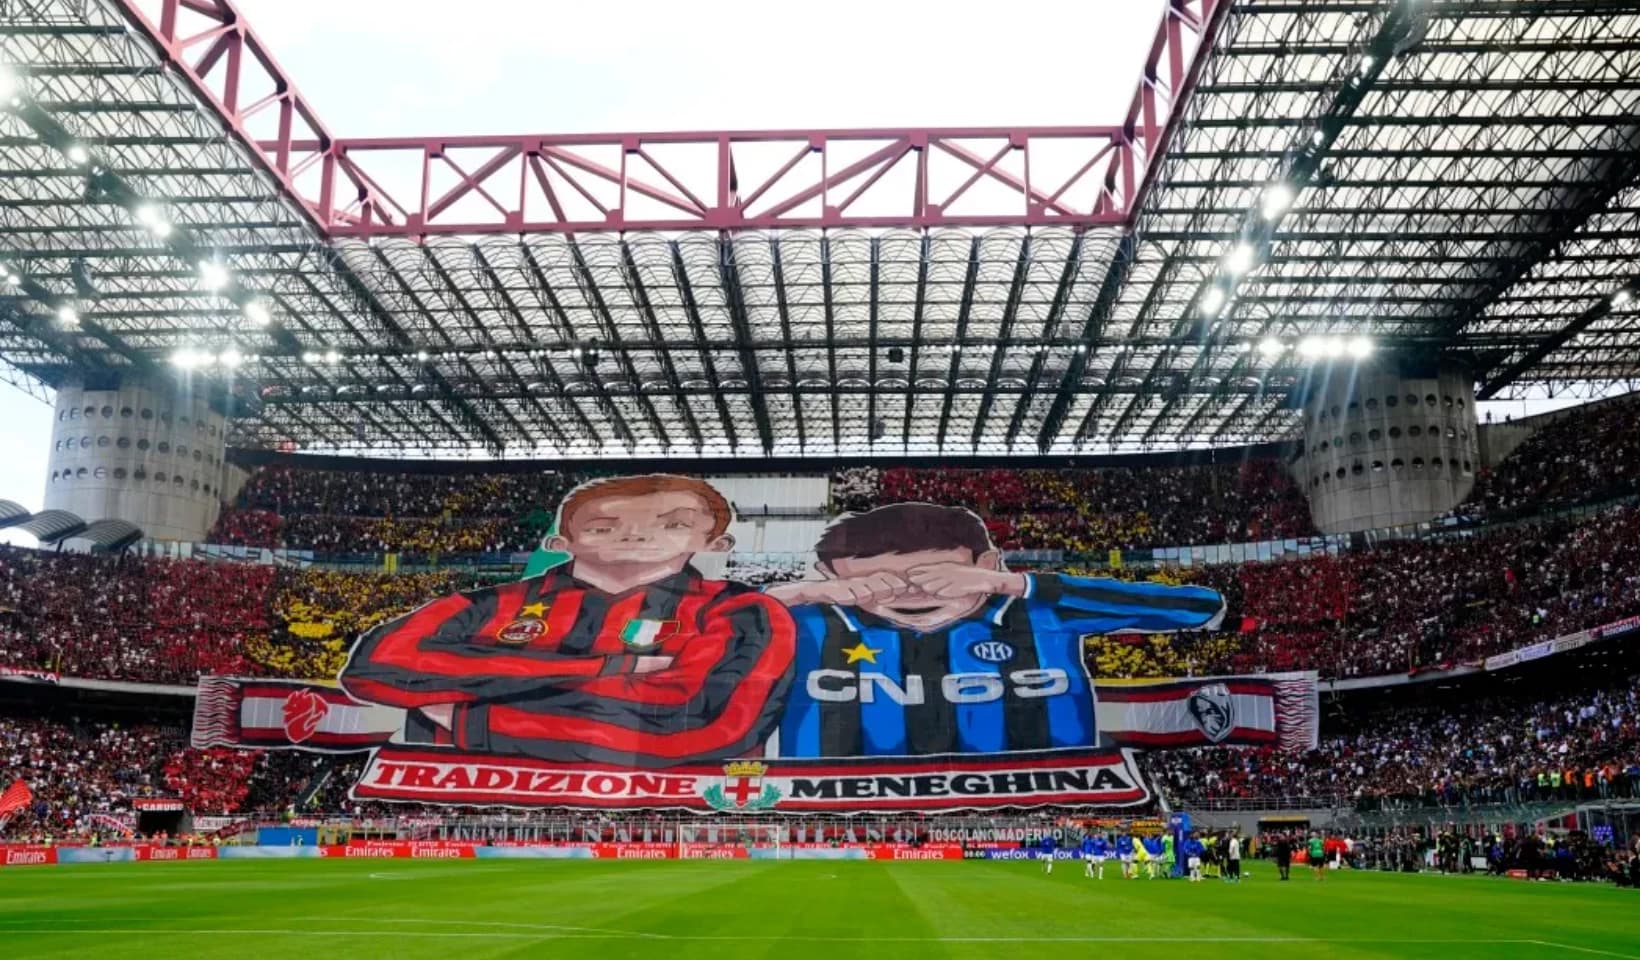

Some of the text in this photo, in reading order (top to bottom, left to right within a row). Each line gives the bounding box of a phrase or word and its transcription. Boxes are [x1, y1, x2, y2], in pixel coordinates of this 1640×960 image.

[806, 668, 1069, 705] CN 69
[373, 763, 1132, 799] TRADIZIONE MENEGHINA
[345, 845, 394, 857] Emirates
[411, 845, 460, 857] Emirates
[617, 847, 666, 859] Emirates
[893, 847, 944, 859] Emirates
[991, 848, 1028, 859] wefox
